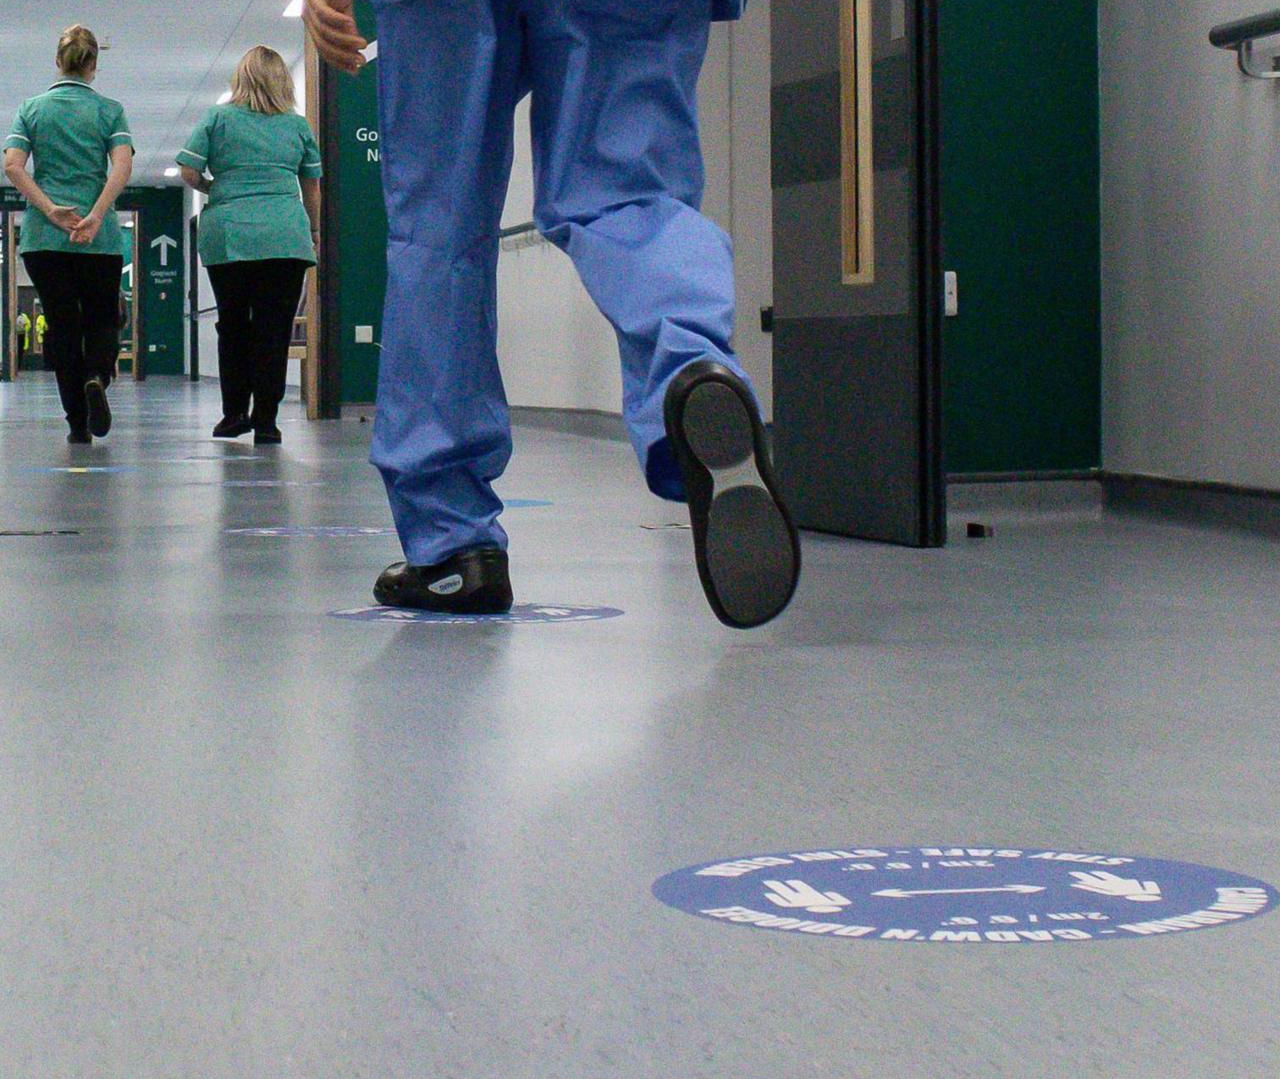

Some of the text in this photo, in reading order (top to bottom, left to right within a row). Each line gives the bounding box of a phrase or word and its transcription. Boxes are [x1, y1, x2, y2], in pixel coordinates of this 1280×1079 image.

[790, 849, 890, 862] STAY
[920, 848, 1023, 858] SAFE
[1028, 852, 1135, 866] STAY
[694, 856, 795, 877] CLEAR
[1047, 912, 1110, 921] 2m
[1116, 910, 1243, 935] DRAW
[879, 928, 1093, 942] CADW'N
